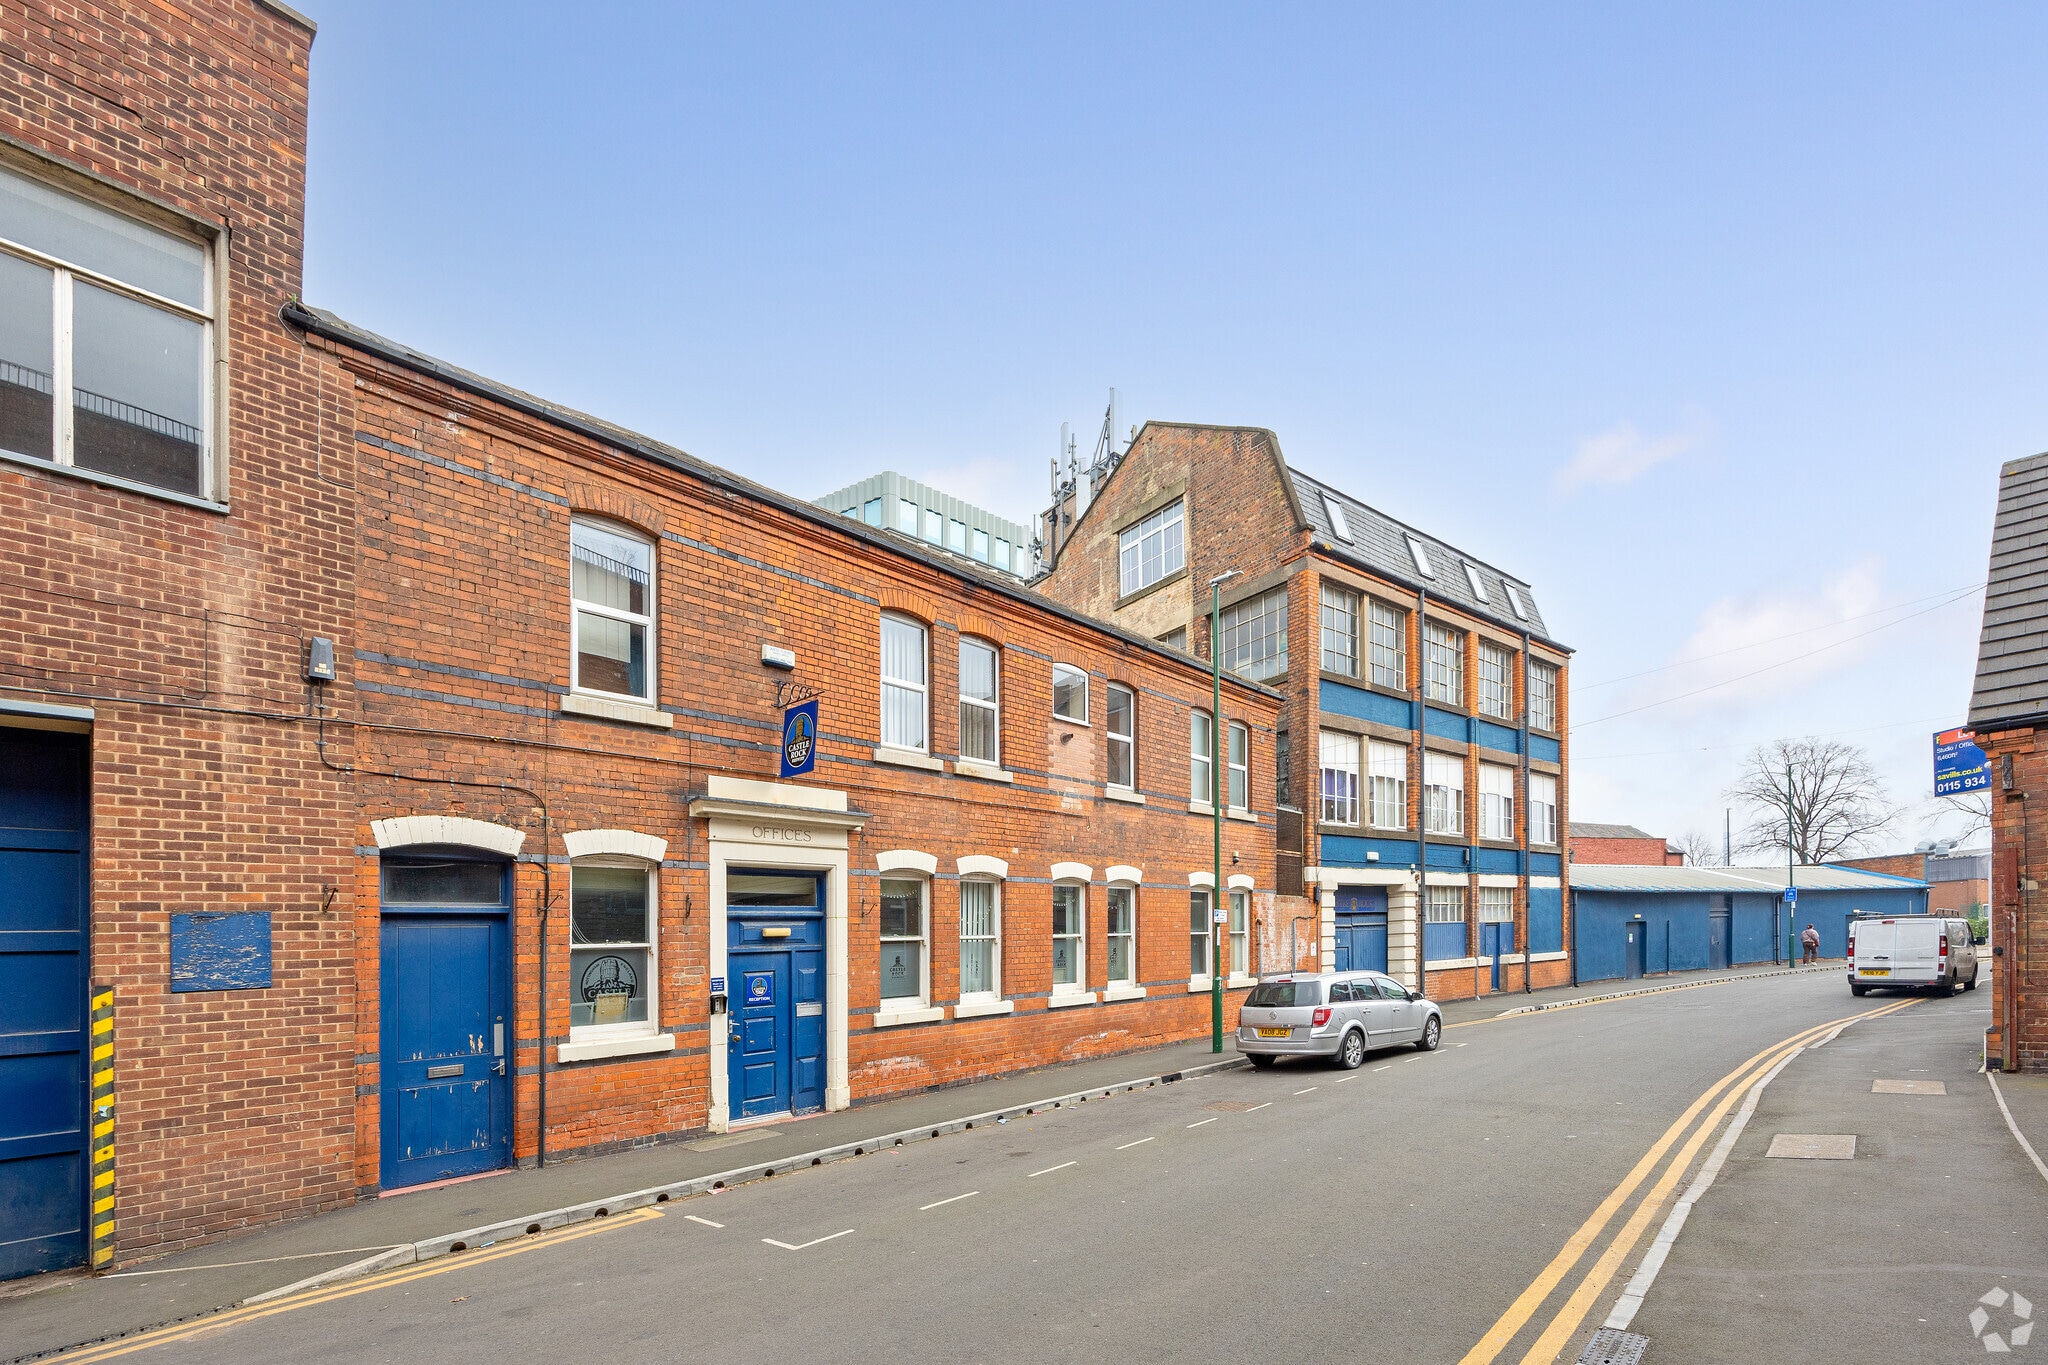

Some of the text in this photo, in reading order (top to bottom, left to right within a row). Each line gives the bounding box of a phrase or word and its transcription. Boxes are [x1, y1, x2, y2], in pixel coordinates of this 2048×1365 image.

[788, 740, 810, 752] CASTLE
[1936, 745, 1954, 754] Studio
[1958, 740, 1975, 749] Offic
[790, 748, 807, 759] ROCK
[1937, 766, 1983, 781] savills.co.uk
[1937, 780, 1961, 793] 0115
[1964, 775, 1986, 788] 934
[752, 825, 812, 842] OFFICES
